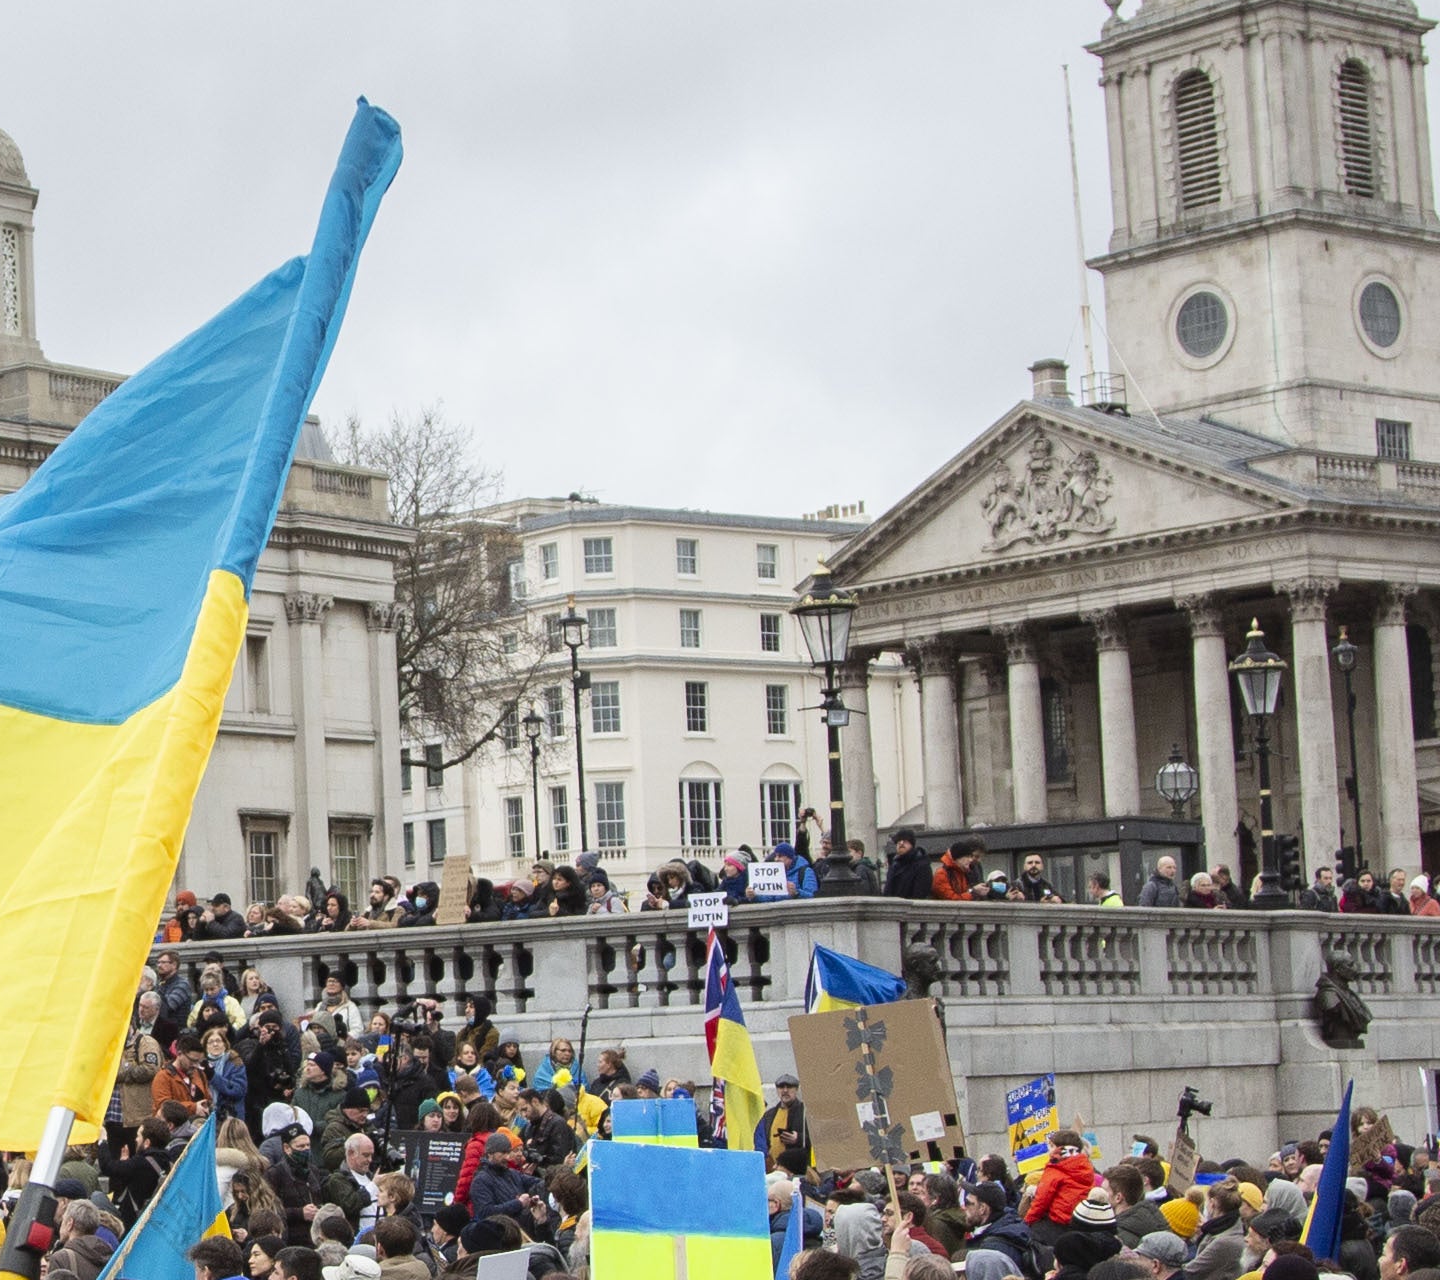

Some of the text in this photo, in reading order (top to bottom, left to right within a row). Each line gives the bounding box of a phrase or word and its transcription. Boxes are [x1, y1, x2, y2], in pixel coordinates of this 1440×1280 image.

[754, 868, 779, 876] STOP
[753, 882, 783, 891] PUTIN
[693, 898, 719, 907] STOP
[692, 912, 723, 922] PUTIN
